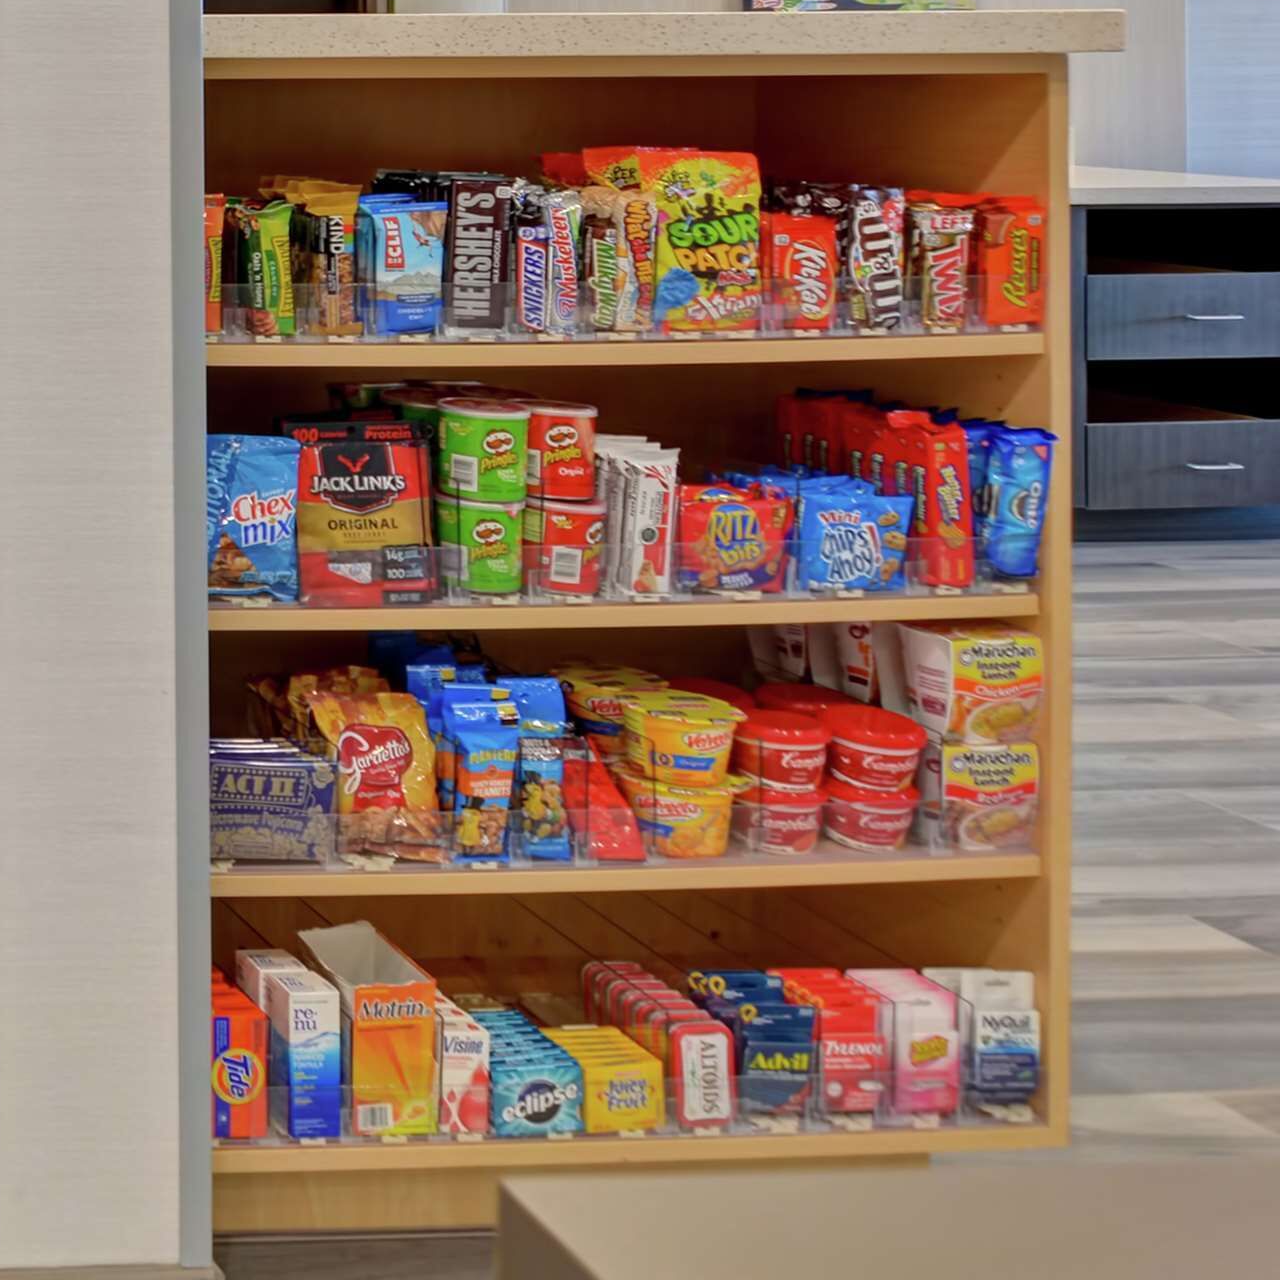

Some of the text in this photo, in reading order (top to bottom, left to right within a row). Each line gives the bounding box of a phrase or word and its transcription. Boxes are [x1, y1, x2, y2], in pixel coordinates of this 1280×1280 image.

[329, 215, 344, 255] KIND
[383, 218, 402, 258] CLIF
[666, 212, 758, 247] SOUR
[453, 191, 496, 318] HERSHEY'S
[494, 229, 504, 286] MILK CHOCOLATE
[1002, 227, 1031, 308] Reese's
[252, 251, 262, 309] Oats Honey
[523, 245, 548, 327] SNICKERS
[294, 427, 320, 442] 100
[364, 428, 412, 440] Protein
[309, 474, 406, 493] JACK LINK'S
[231, 489, 297, 523] Chex
[1026, 481, 1043, 529] OREO
[326, 518, 399, 531] ORIGINAL
[708, 510, 760, 544] RITZ
[818, 511, 861, 525] Mini
[241, 519, 292, 548] mix
[821, 526, 872, 558] Chips
[722, 544, 762, 564] bits
[386, 568, 406, 579] 100
[969, 641, 1036, 658] Maruchan
[976, 661, 1022, 670] Instant
[981, 670, 1017, 680] Lunch
[975, 685, 1019, 697] Chicken
[339, 731, 410, 794] Gardetto's
[963, 751, 1032, 768] Maruchan
[969, 767, 1015, 777] Instant
[974, 777, 1011, 787] Lunch
[219, 773, 297, 796] ACT II
[358, 999, 426, 1021] Motrin
[981, 1015, 1032, 1031] NyQuil
[443, 1036, 484, 1055] Visine
[823, 1039, 883, 1056] TYLENOL
[749, 1052, 811, 1071] Advil
[222, 1054, 252, 1099] Tide
[609, 1079, 649, 1094] Juicy
[700, 1039, 721, 1114] ALTOIDS
[501, 1082, 579, 1123] eclipse
[607, 1092, 649, 1111] Fruit
